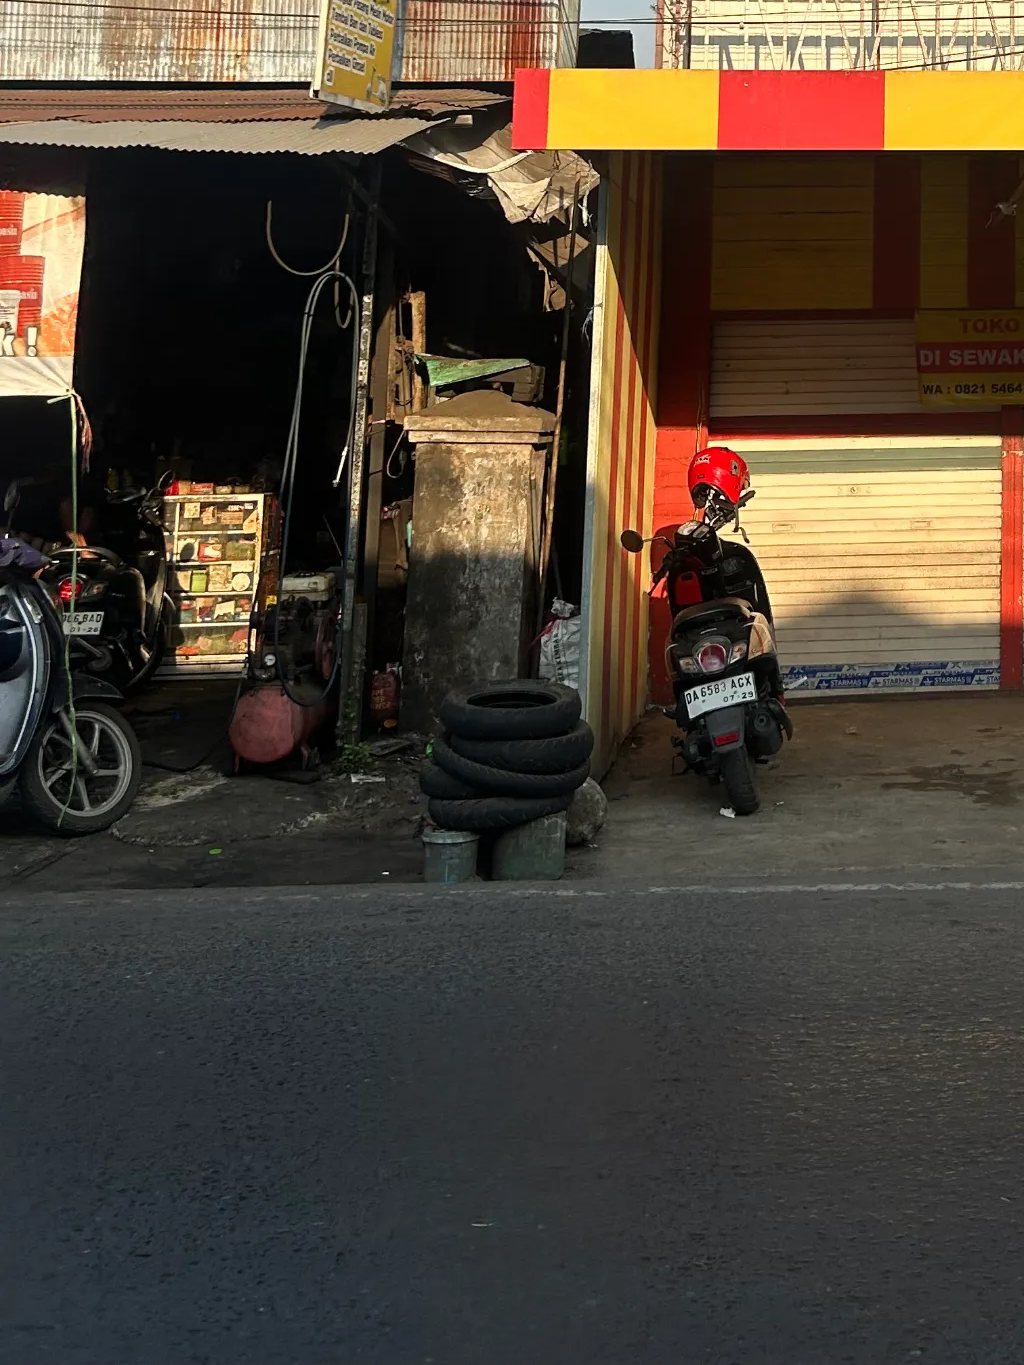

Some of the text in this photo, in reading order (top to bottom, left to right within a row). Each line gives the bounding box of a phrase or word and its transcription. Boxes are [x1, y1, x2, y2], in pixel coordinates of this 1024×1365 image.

[959, 318, 1020, 334] TOKO
[919, 349, 940, 366] DI
[923, 384, 943, 394] WA
[955, 383, 986, 395] 0821
[991, 383, 1022, 394] 5464
[830, 678, 863, 687] STARMAS
[882, 677, 915, 685] STARMAS
[934, 676, 967, 684] STARMAS
[685, 690, 700, 705] DA
[700, 681, 727, 698] 6583
